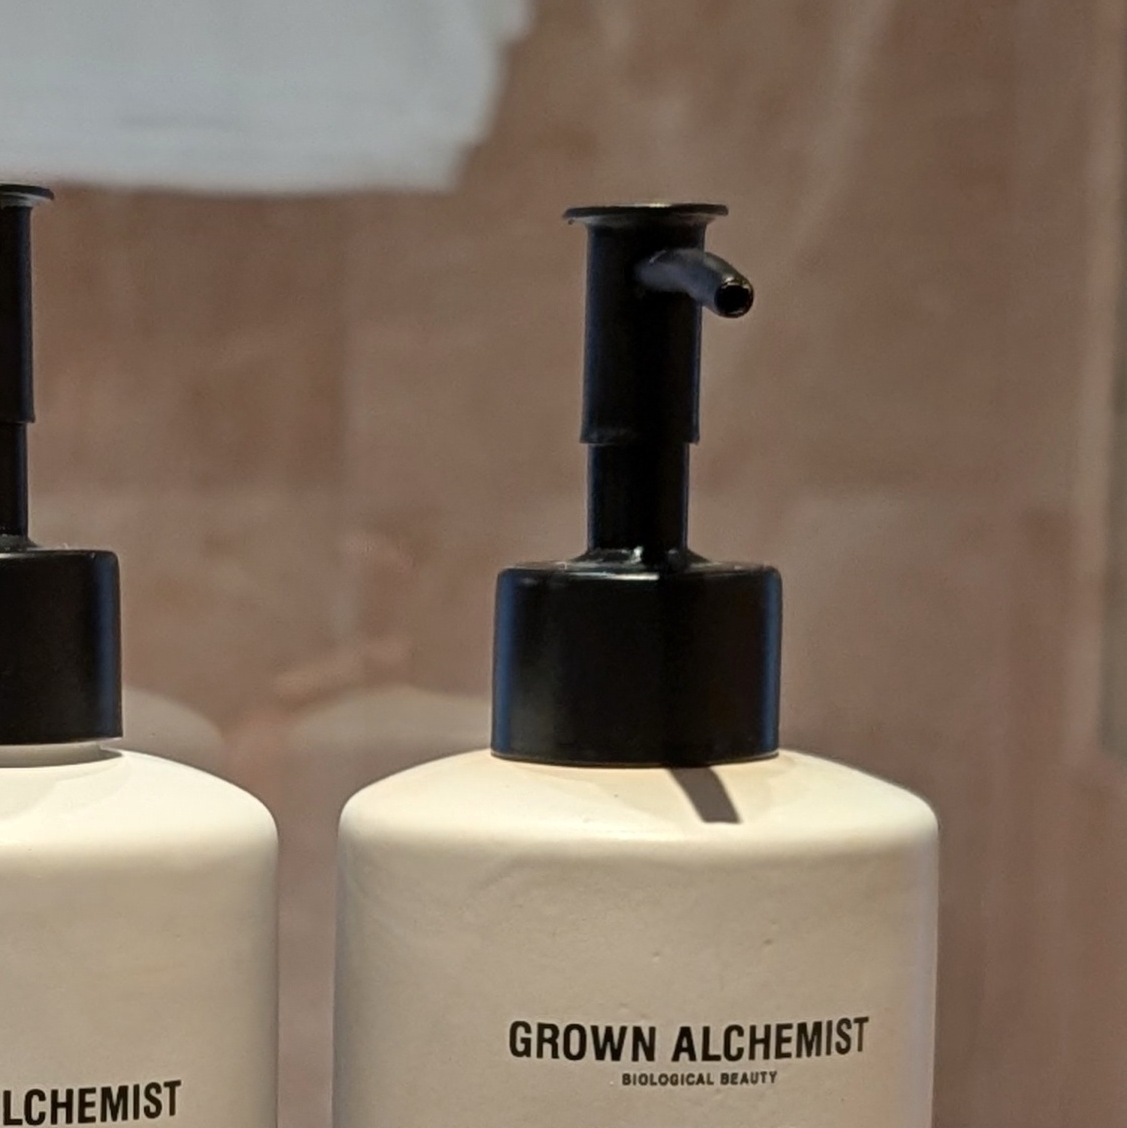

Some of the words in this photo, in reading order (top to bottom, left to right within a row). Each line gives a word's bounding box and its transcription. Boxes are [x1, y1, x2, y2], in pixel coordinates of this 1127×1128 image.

[510, 1020, 656, 1062] GROWN
[671, 1017, 870, 1062] ALCHEMIST
[622, 1073, 715, 1086] BIOLOGICAL
[720, 1071, 778, 1085] BEAUTY
